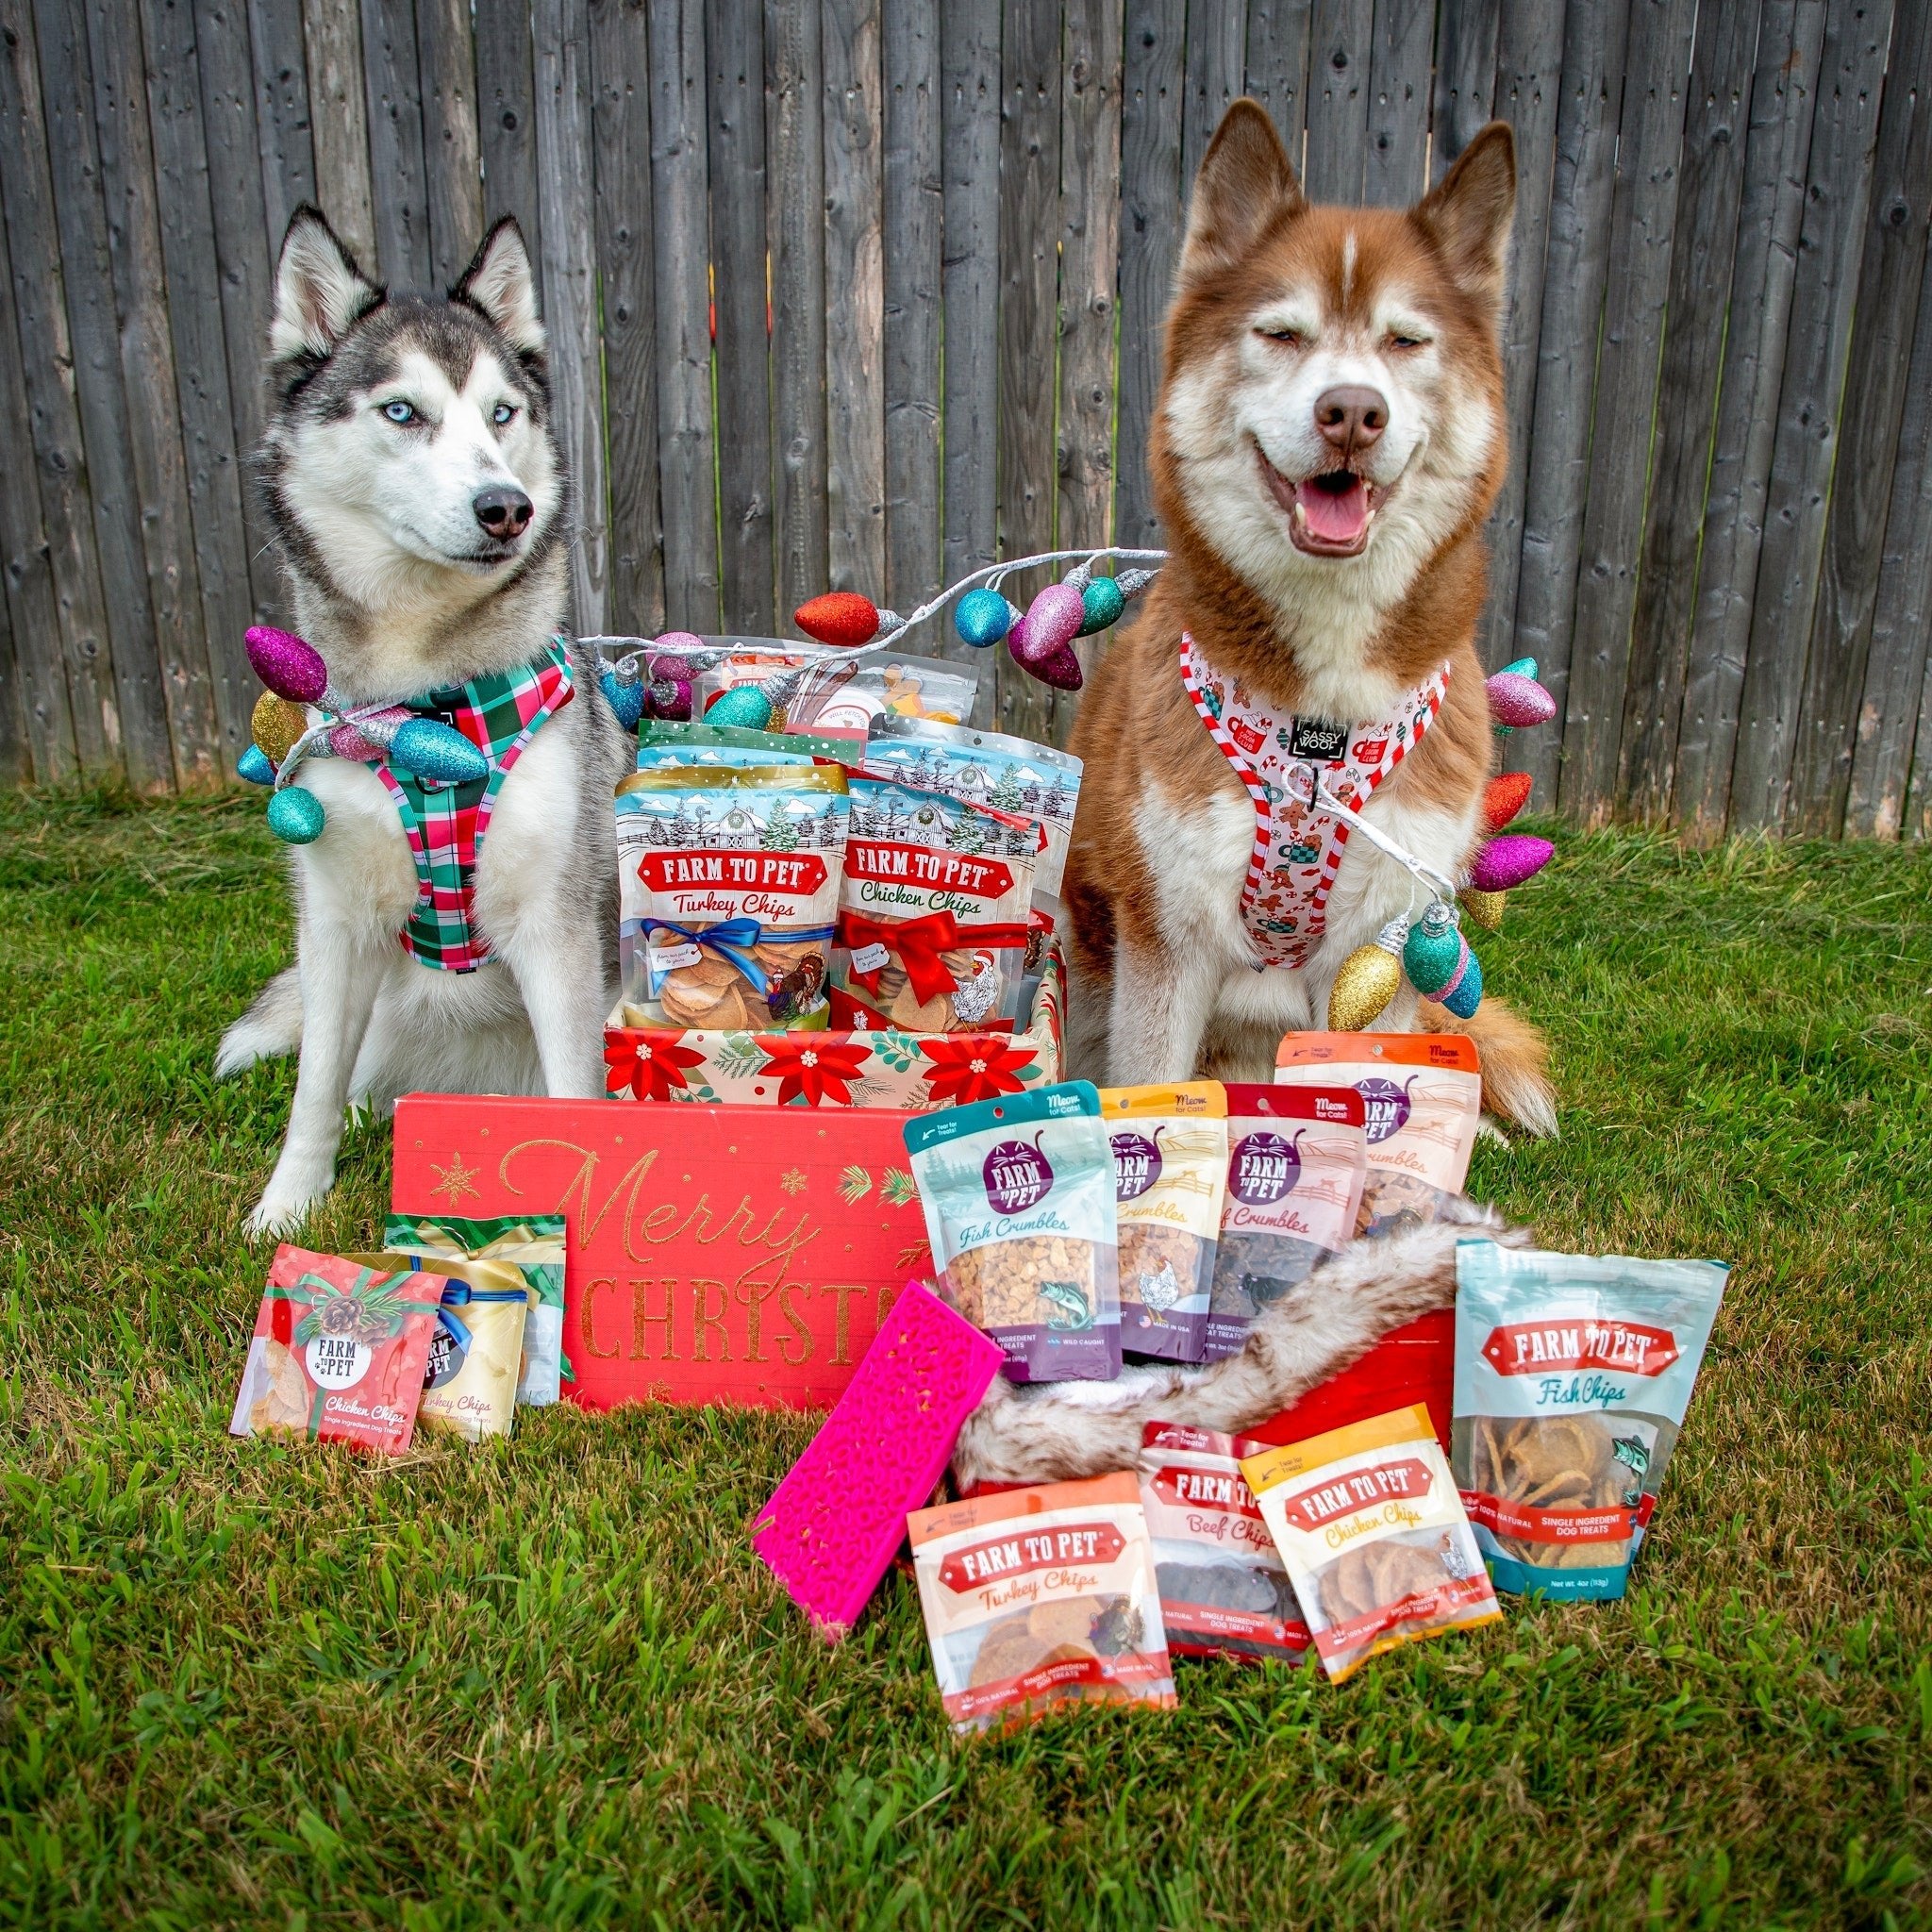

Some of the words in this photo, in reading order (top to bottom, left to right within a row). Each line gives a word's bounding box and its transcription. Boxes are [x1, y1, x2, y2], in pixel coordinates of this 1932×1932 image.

[1237, 737, 1254, 750] CLUB
[1240, 731, 1256, 744] COCOA
[1300, 737, 1338, 751] WOOF
[1303, 730, 1341, 743] SASSY
[662, 858, 723, 883] FARM
[729, 858, 757, 883] TO
[856, 848, 908, 875] FARM
[914, 853, 940, 881] TO
[674, 891, 737, 920] Turkey
[741, 894, 795, 922] Chips
[860, 882, 924, 907] Chicken
[928, 891, 981, 919] Chips
[1429, 1045, 1459, 1057] Meow
[1046, 1093, 1080, 1108] Meow
[1060, 1104, 1081, 1113] Cats!
[1175, 1094, 1207, 1105] Meow
[1314, 1097, 1348, 1111] Meow
[1327, 1110, 1347, 1119] Cats!
[1114, 1156, 1150, 1177] ARM
[1239, 1155, 1289, 1179] FARM
[1367, 1150, 1427, 1174] rumbles
[991, 1161, 1041, 1191] FARM
[1000, 1191, 1009, 1201] TO
[1006, 1184, 1041, 1208] PET
[1240, 1177, 1250, 1187] TO
[1245, 1177, 1284, 1199] PET
[499, 1139, 821, 1307] Merry
[959, 1221, 992, 1248] Fish
[996, 1211, 1070, 1237] Crumbles
[1234, 1207, 1309, 1233] Crumbles
[581, 1276, 895, 1367] CHRIST
[319, 1339, 357, 1358] FARM
[1514, 1328, 1581, 1365] FARM
[1585, 1327, 1610, 1358] TO
[321, 1357, 327, 1366] TO
[327, 1358, 354, 1376] PET
[426, 1354, 451, 1377] PET
[1536, 1376, 1580, 1405] Fish
[1582, 1375, 1626, 1408] Chips
[325, 1396, 370, 1417] Chicken
[371, 1405, 406, 1425] Chips
[425, 1393, 455, 1413] urkey
[458, 1395, 492, 1415] Chips
[324, 1415, 341, 1424] Single
[341, 1419, 371, 1430] Ingredient
[372, 1424, 383, 1433] Dog
[384, 1426, 402, 1436] Treats
[1198, 1433, 1209, 1441] for
[1175, 1474, 1232, 1504] FARM
[1301, 1482, 1354, 1522] FARM
[1349, 1474, 1378, 1501] TO
[1325, 1516, 1382, 1548] Chicken
[1384, 1503, 1422, 1527] Chips
[1479, 1505, 1496, 1518] 100%
[1497, 1512, 1533, 1528] NATURAL
[1541, 1516, 1574, 1527] SINGLE
[1575, 1514, 1620, 1525] INGREDIENT
[1186, 1514, 1228, 1541] Beef
[1231, 1520, 1275, 1551] Chips
[1557, 1526, 1578, 1536] DOG
[1580, 1525, 1609, 1535] TREATS
[961, 1541, 1023, 1581] FARM
[1024, 1535, 1054, 1562] TO
[1057, 1531, 1098, 1559] PET
[979, 1580, 1040, 1610] Turkey
[1044, 1570, 1098, 1591] Chips
[1165, 1611, 1192, 1621] NATURAL
[1200, 1611, 1224, 1622] SINGLE
[1225, 1615, 1265, 1628] INGREDIENT
[1210, 1620, 1226, 1629] DOG
[1228, 1623, 1254, 1633] TREATS
[1047, 1662, 1090, 1674] INGREDIENT
[1053, 1670, 1079, 1679] TREATS
